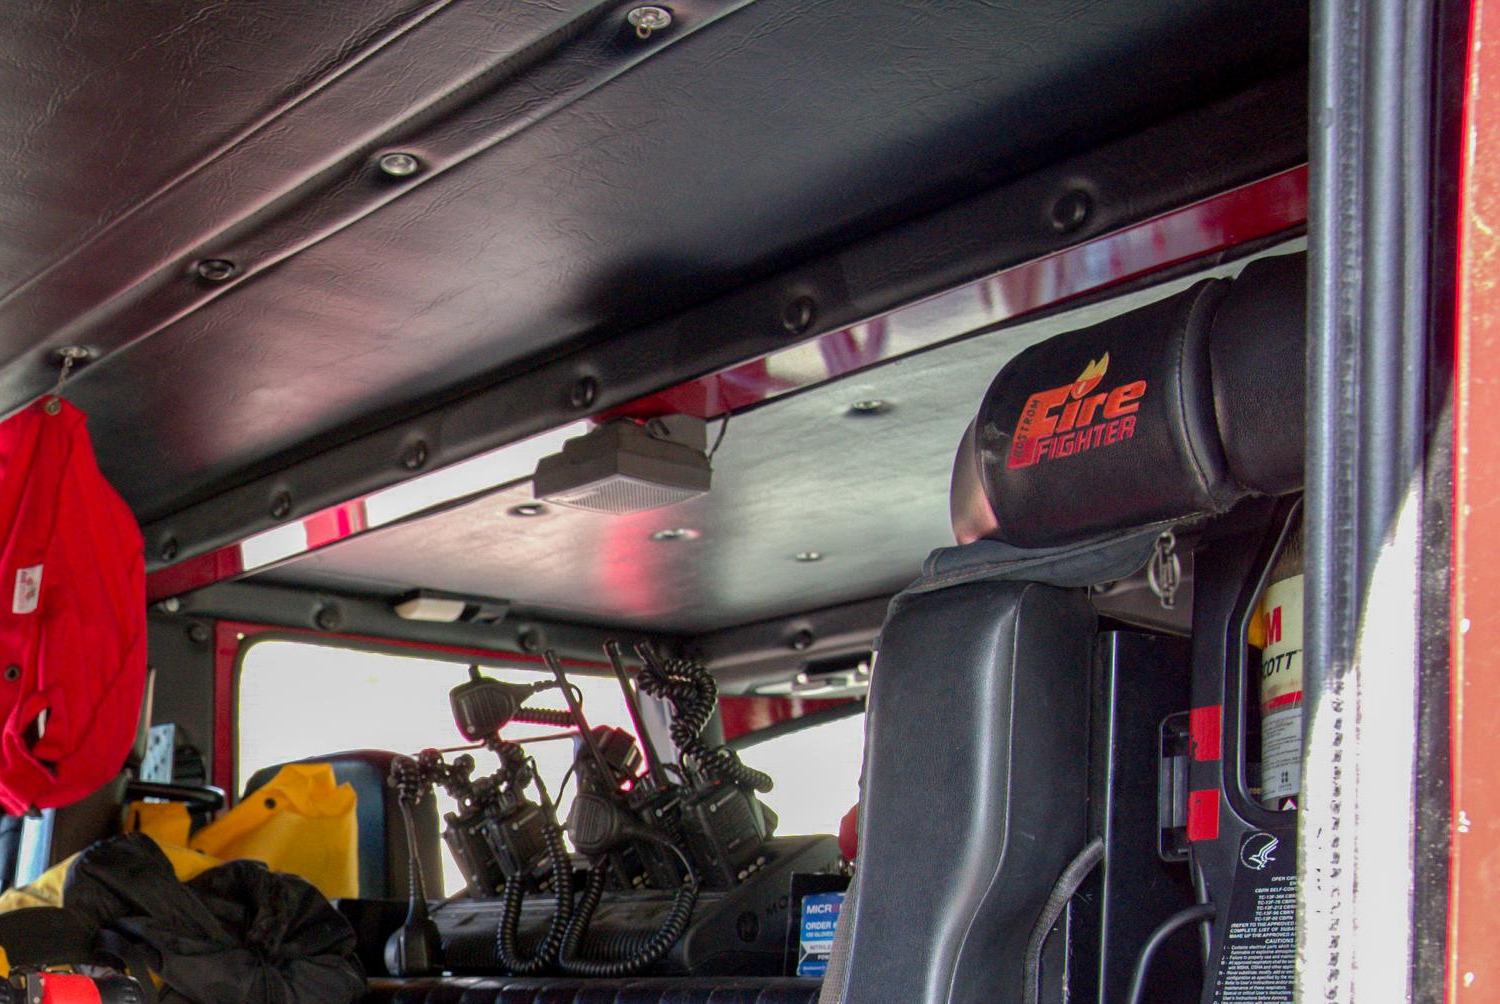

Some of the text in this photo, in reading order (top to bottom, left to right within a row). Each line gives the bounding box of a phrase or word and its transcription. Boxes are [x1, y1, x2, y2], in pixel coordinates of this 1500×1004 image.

[1035, 415, 1138, 465] FIGHTER
[1264, 606, 1282, 649] M
[1261, 650, 1298, 679] COTT
[806, 904, 842, 915] MICR
